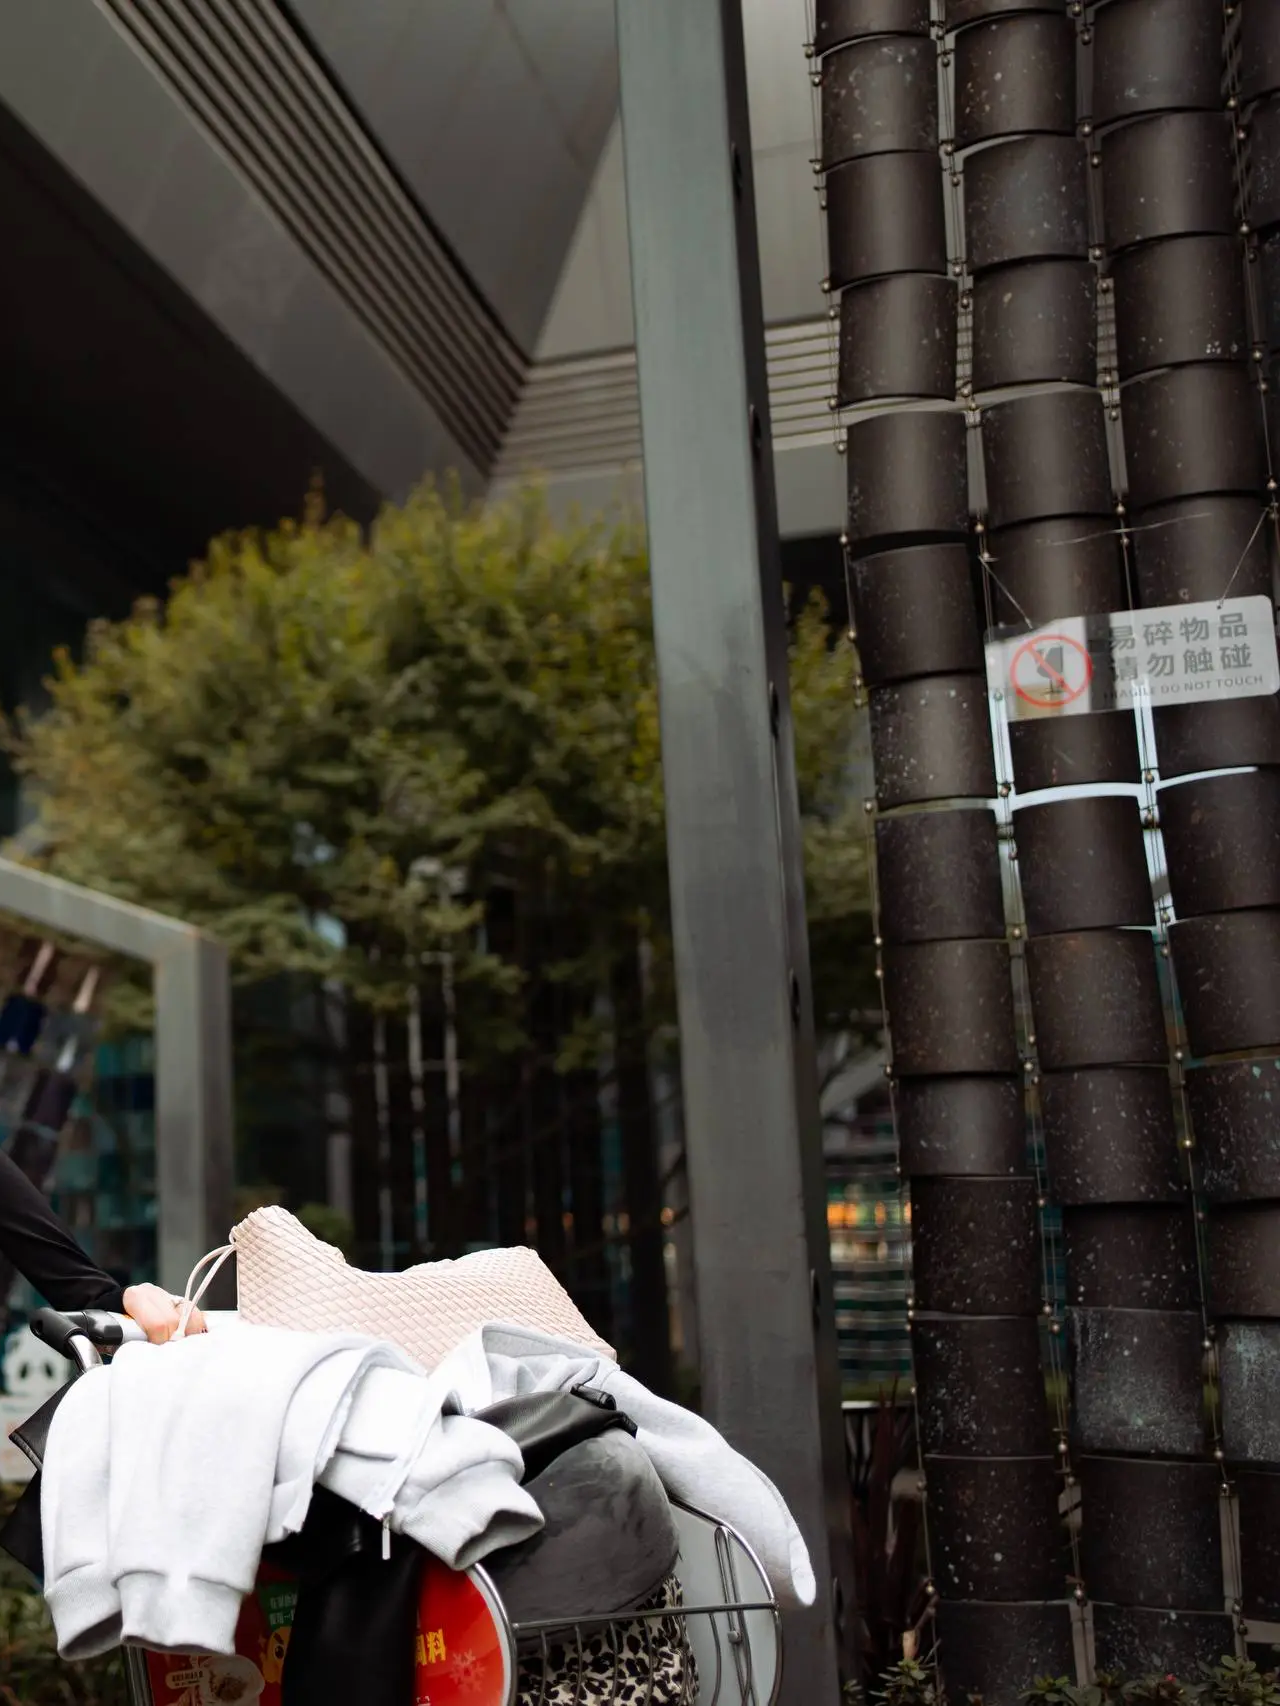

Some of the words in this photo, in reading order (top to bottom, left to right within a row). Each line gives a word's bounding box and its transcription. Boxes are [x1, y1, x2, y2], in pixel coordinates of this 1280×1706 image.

[1109, 612, 1248, 651] 易碎物品
[1161, 683, 1181, 695] DO
[1184, 679, 1212, 692] NOT
[1217, 675, 1264, 688] TOUCH
